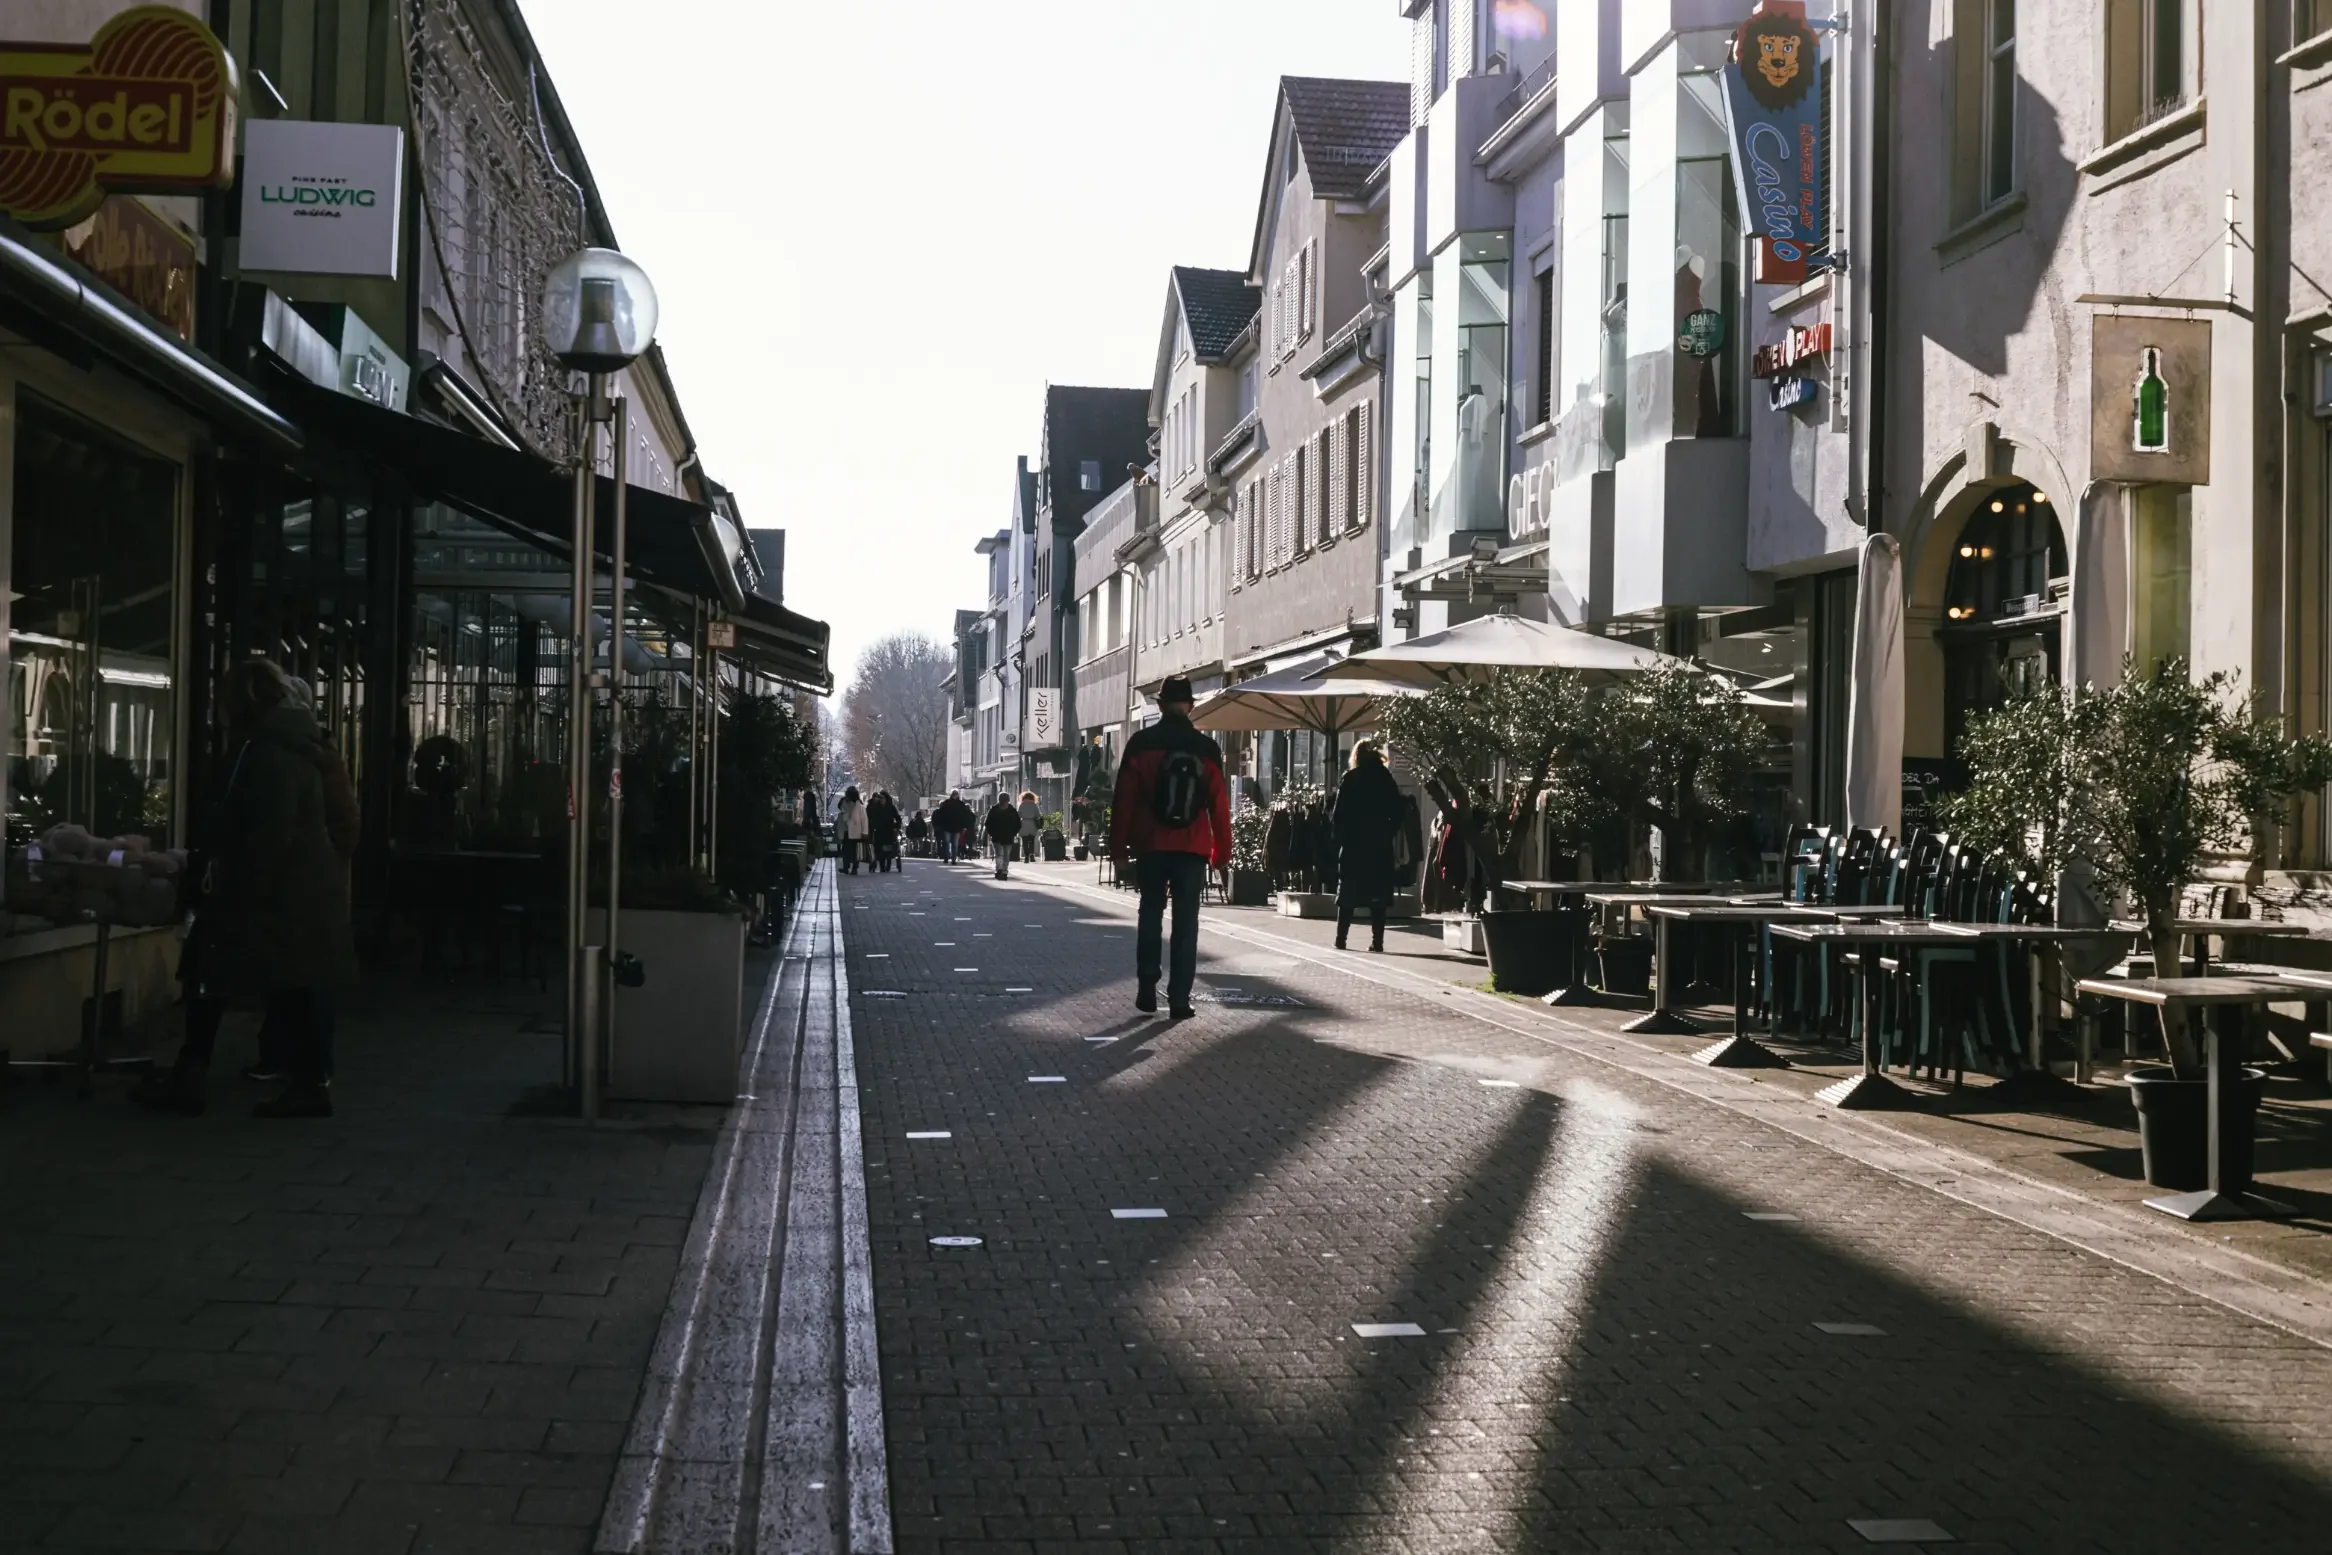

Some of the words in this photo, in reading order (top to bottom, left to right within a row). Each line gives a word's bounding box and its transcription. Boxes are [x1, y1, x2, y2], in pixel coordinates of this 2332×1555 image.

[4, 87, 182, 151] Rödel
[1800, 123, 1815, 185] LÖWEN
[261, 185, 375, 207] LUDWIG
[1745, 121, 1801, 262] Casino
[1799, 187, 1815, 231] PLAY
[1690, 312, 1717, 327] GANZ
[1795, 322, 1822, 361] PLAY
[1769, 375, 1802, 412] Casino
